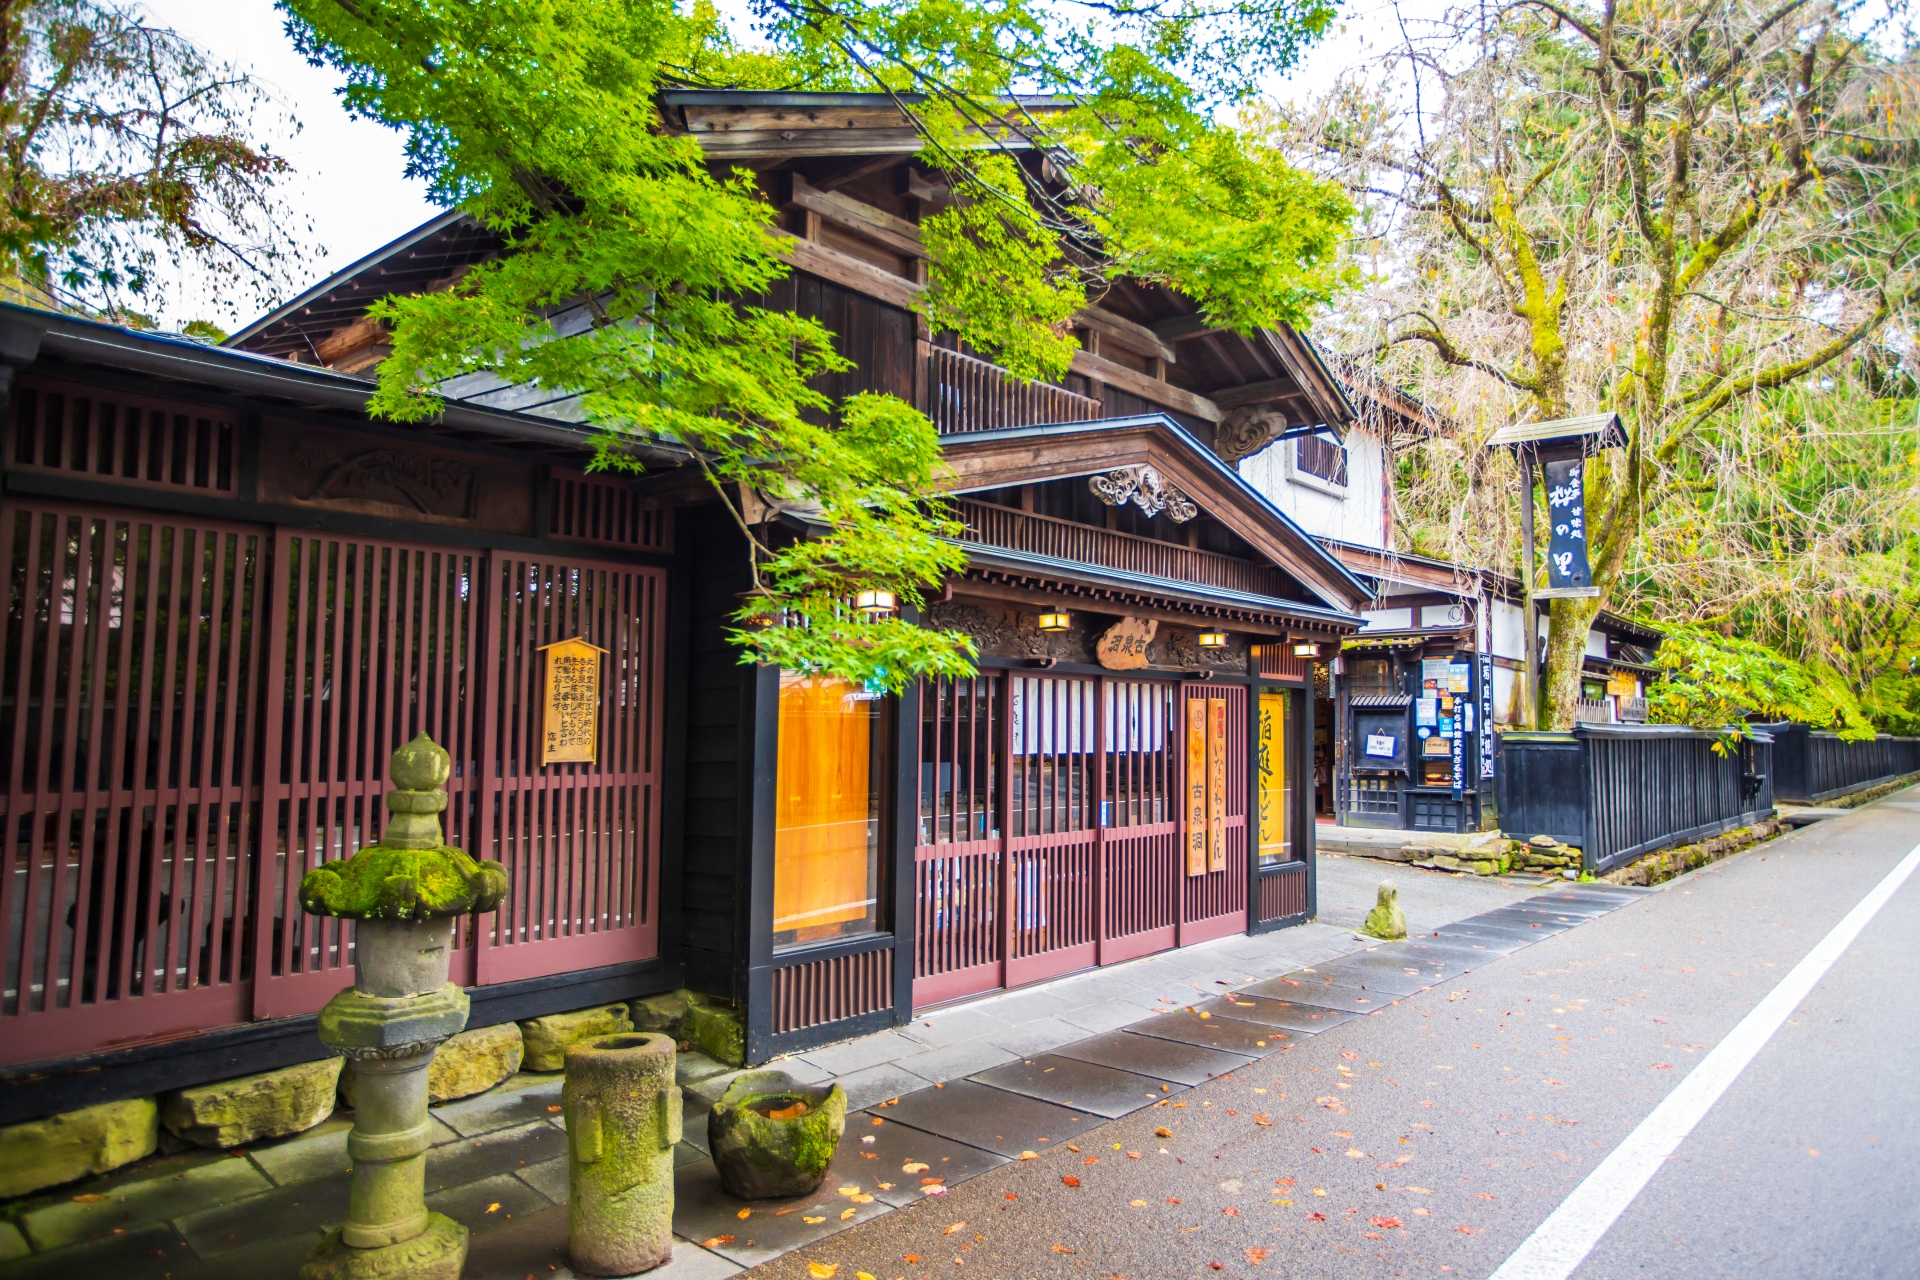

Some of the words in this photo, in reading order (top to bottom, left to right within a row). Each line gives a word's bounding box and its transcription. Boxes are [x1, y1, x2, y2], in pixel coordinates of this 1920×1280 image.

[1549, 485, 1576, 576] 桜の里
[1570, 507, 1583, 540] 甘味処
[547, 731, 557, 753] 店主
